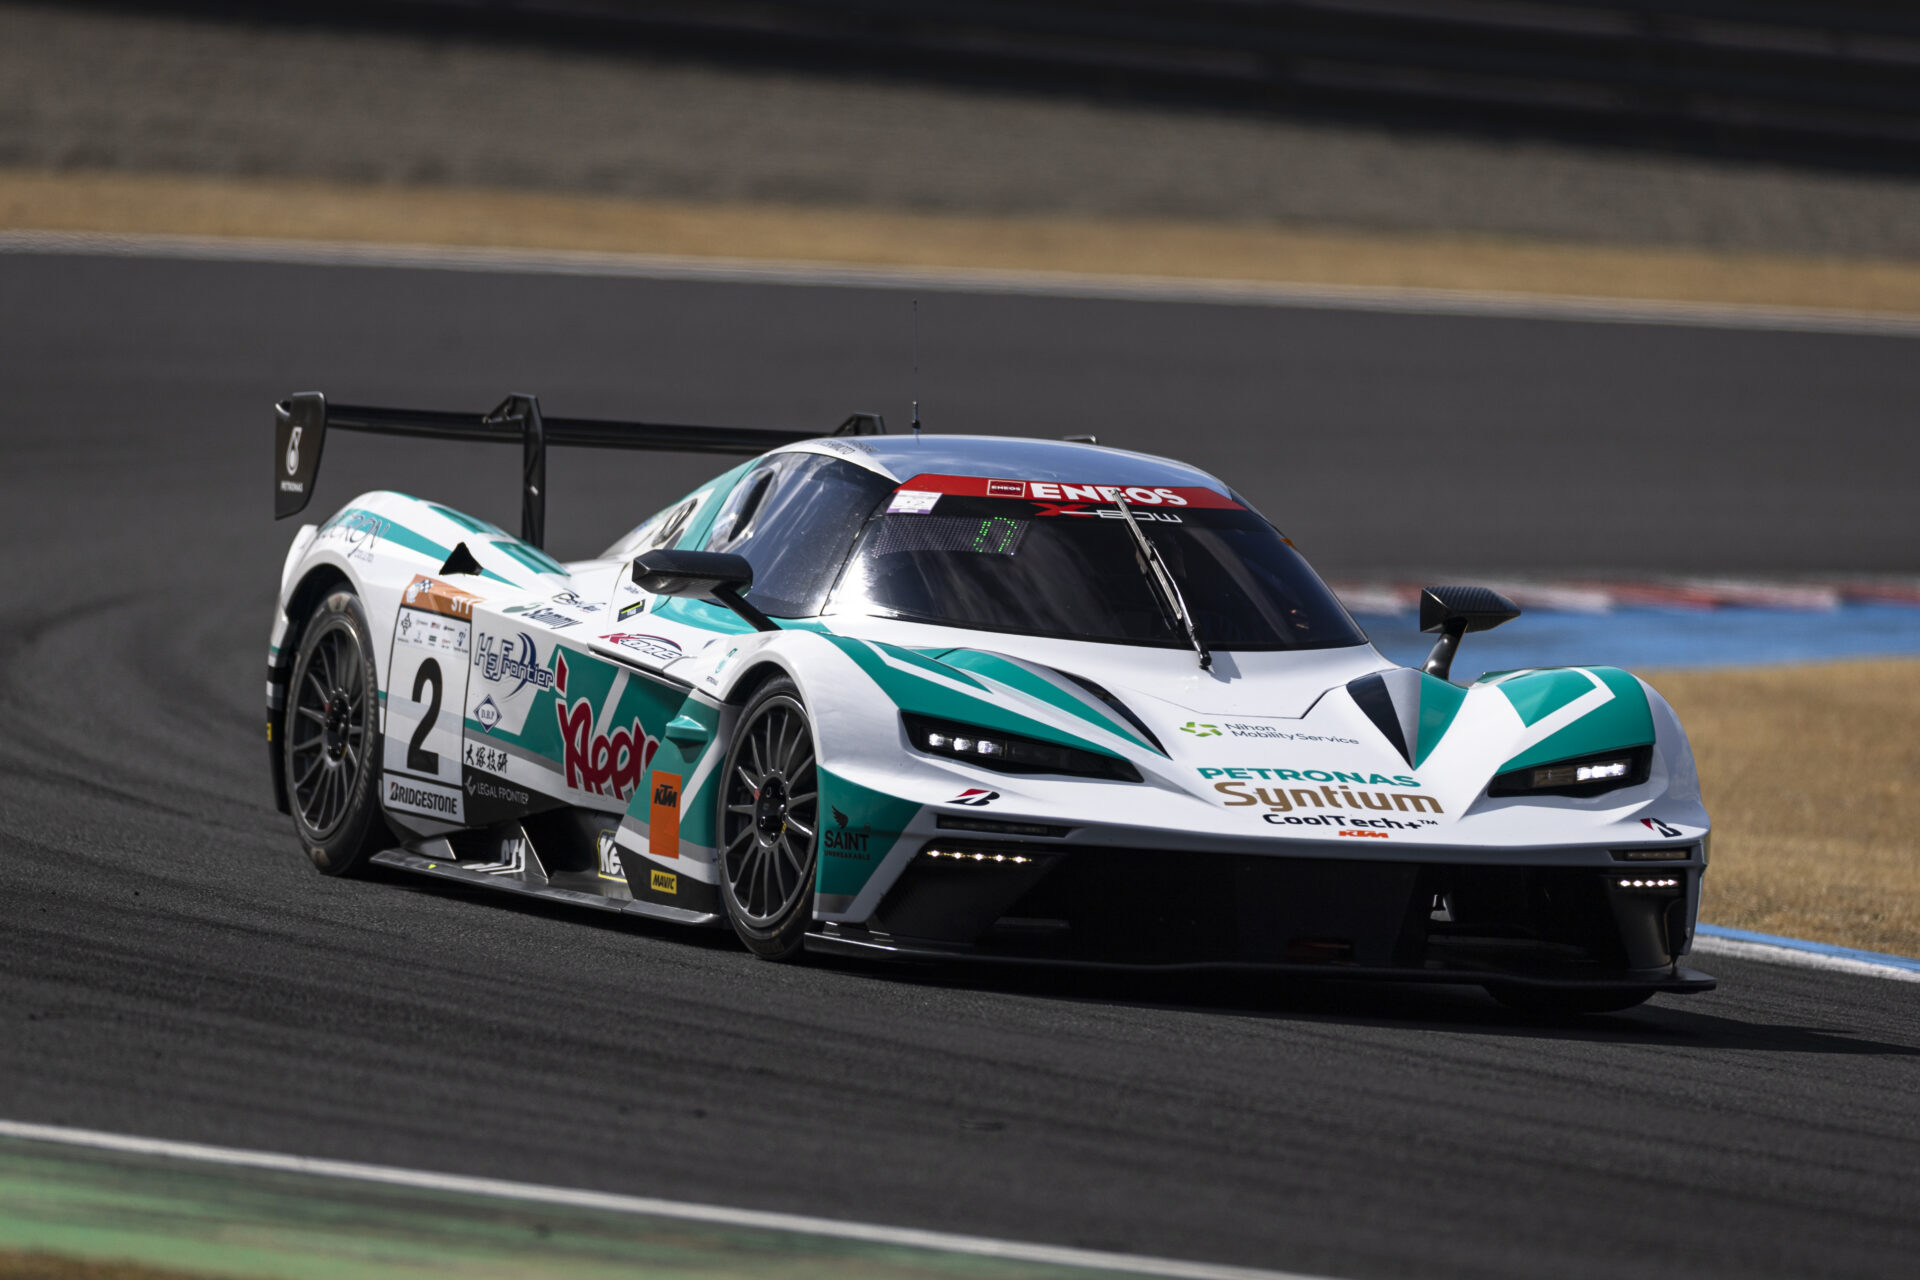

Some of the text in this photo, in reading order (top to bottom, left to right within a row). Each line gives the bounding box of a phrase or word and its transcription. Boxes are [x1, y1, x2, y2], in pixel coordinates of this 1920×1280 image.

[991, 484, 1021, 492] ENEOS
[1030, 482, 1188, 506] ENEOS
[407, 657, 443, 775] 2
[1225, 723, 1277, 732] Nihon
[1231, 730, 1359, 745] Mobility Service
[1197, 767, 1421, 787] PETRONAS
[390, 781, 457, 815] BRIDGESTONE
[477, 782, 529, 805] LEGAL FRONTIER
[654, 784, 678, 808] KTM
[1214, 781, 1444, 813] Syntium
[824, 829, 870, 852] SAINT
[1338, 829, 1389, 838] KTM
[652, 873, 675, 892] MAVIC
